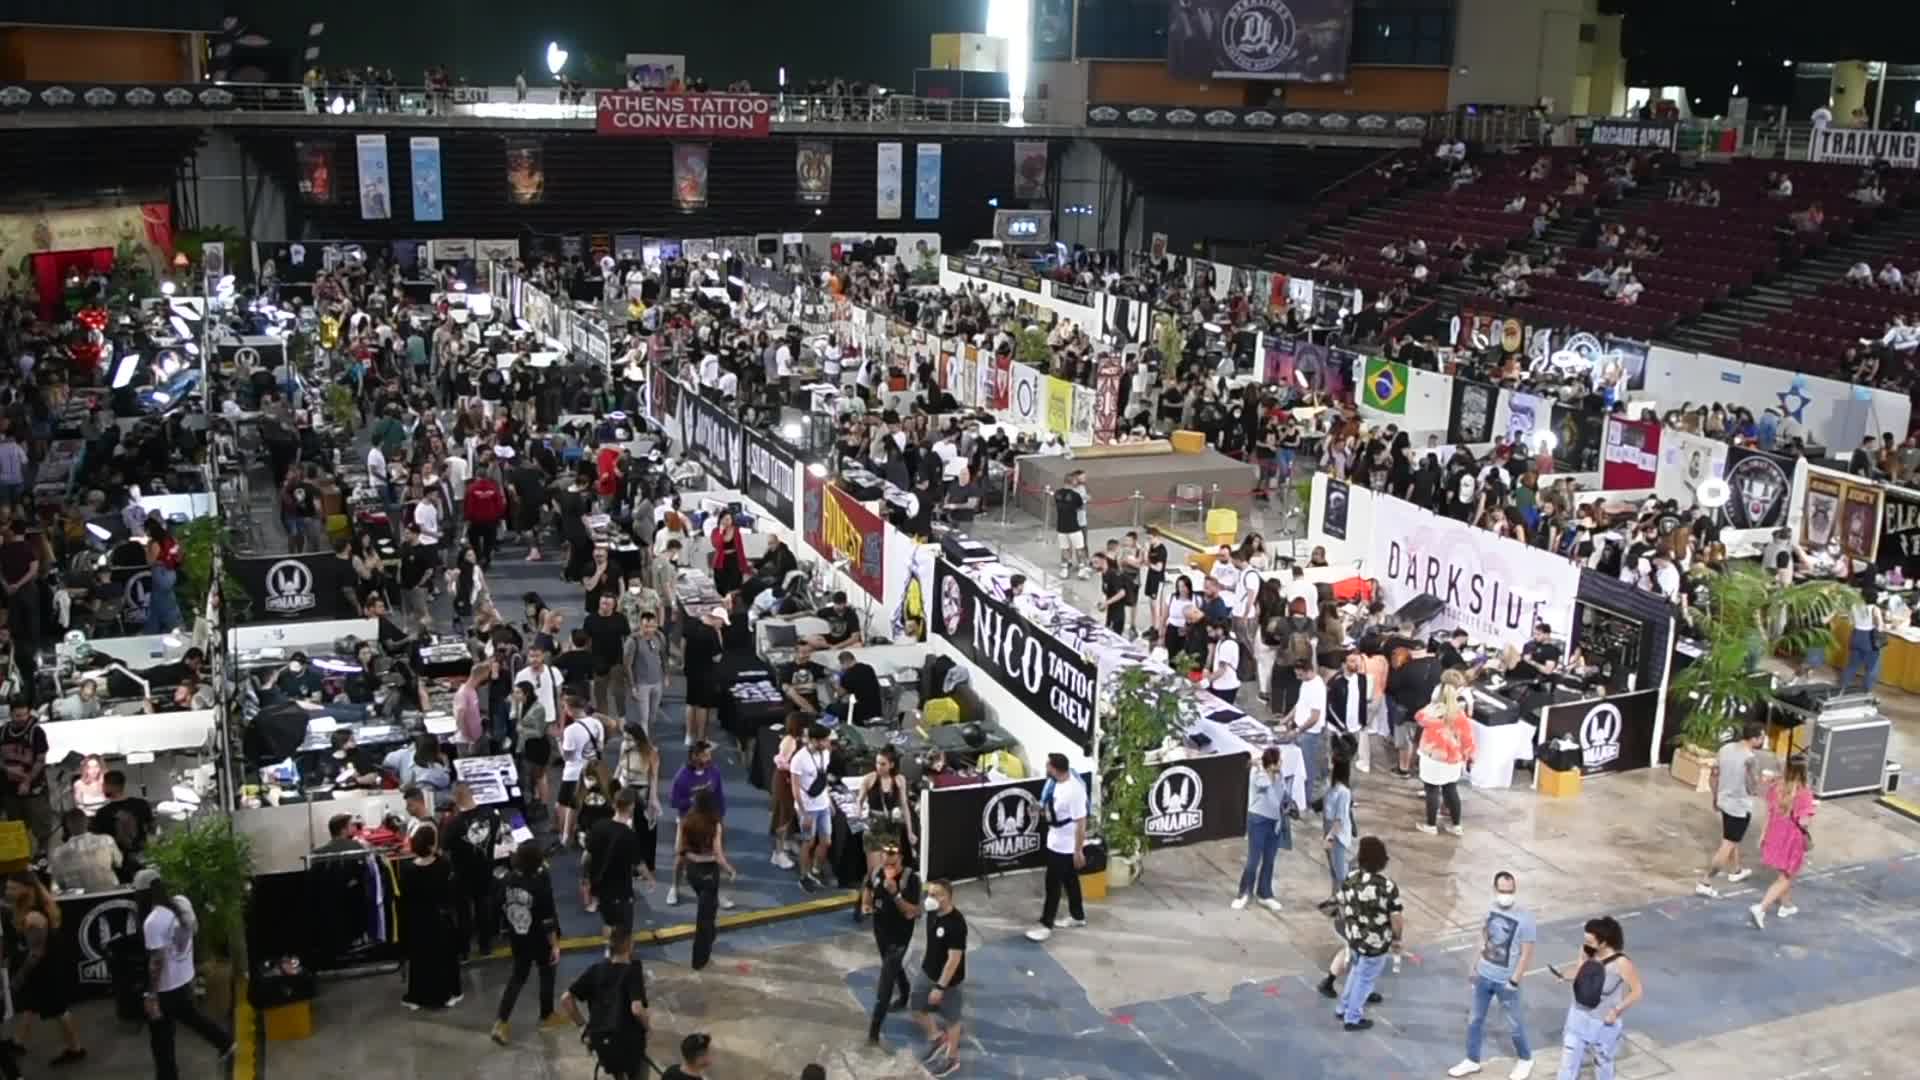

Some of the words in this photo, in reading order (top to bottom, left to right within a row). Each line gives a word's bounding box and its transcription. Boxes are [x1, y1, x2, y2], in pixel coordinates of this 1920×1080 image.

[600, 96, 683, 112] ATHENS
[688, 98, 768, 113] TATTOO
[613, 112, 753, 129] CONVENTION
[1592, 125, 1639, 146] ARCADE
[1640, 127, 1671, 149] AREA
[1822, 130, 1917, 159] TRAINING
[973, 596, 1043, 694] NICO
[1050, 685, 1090, 733] CREW
[1148, 812, 1200, 832] DYNAMIC
